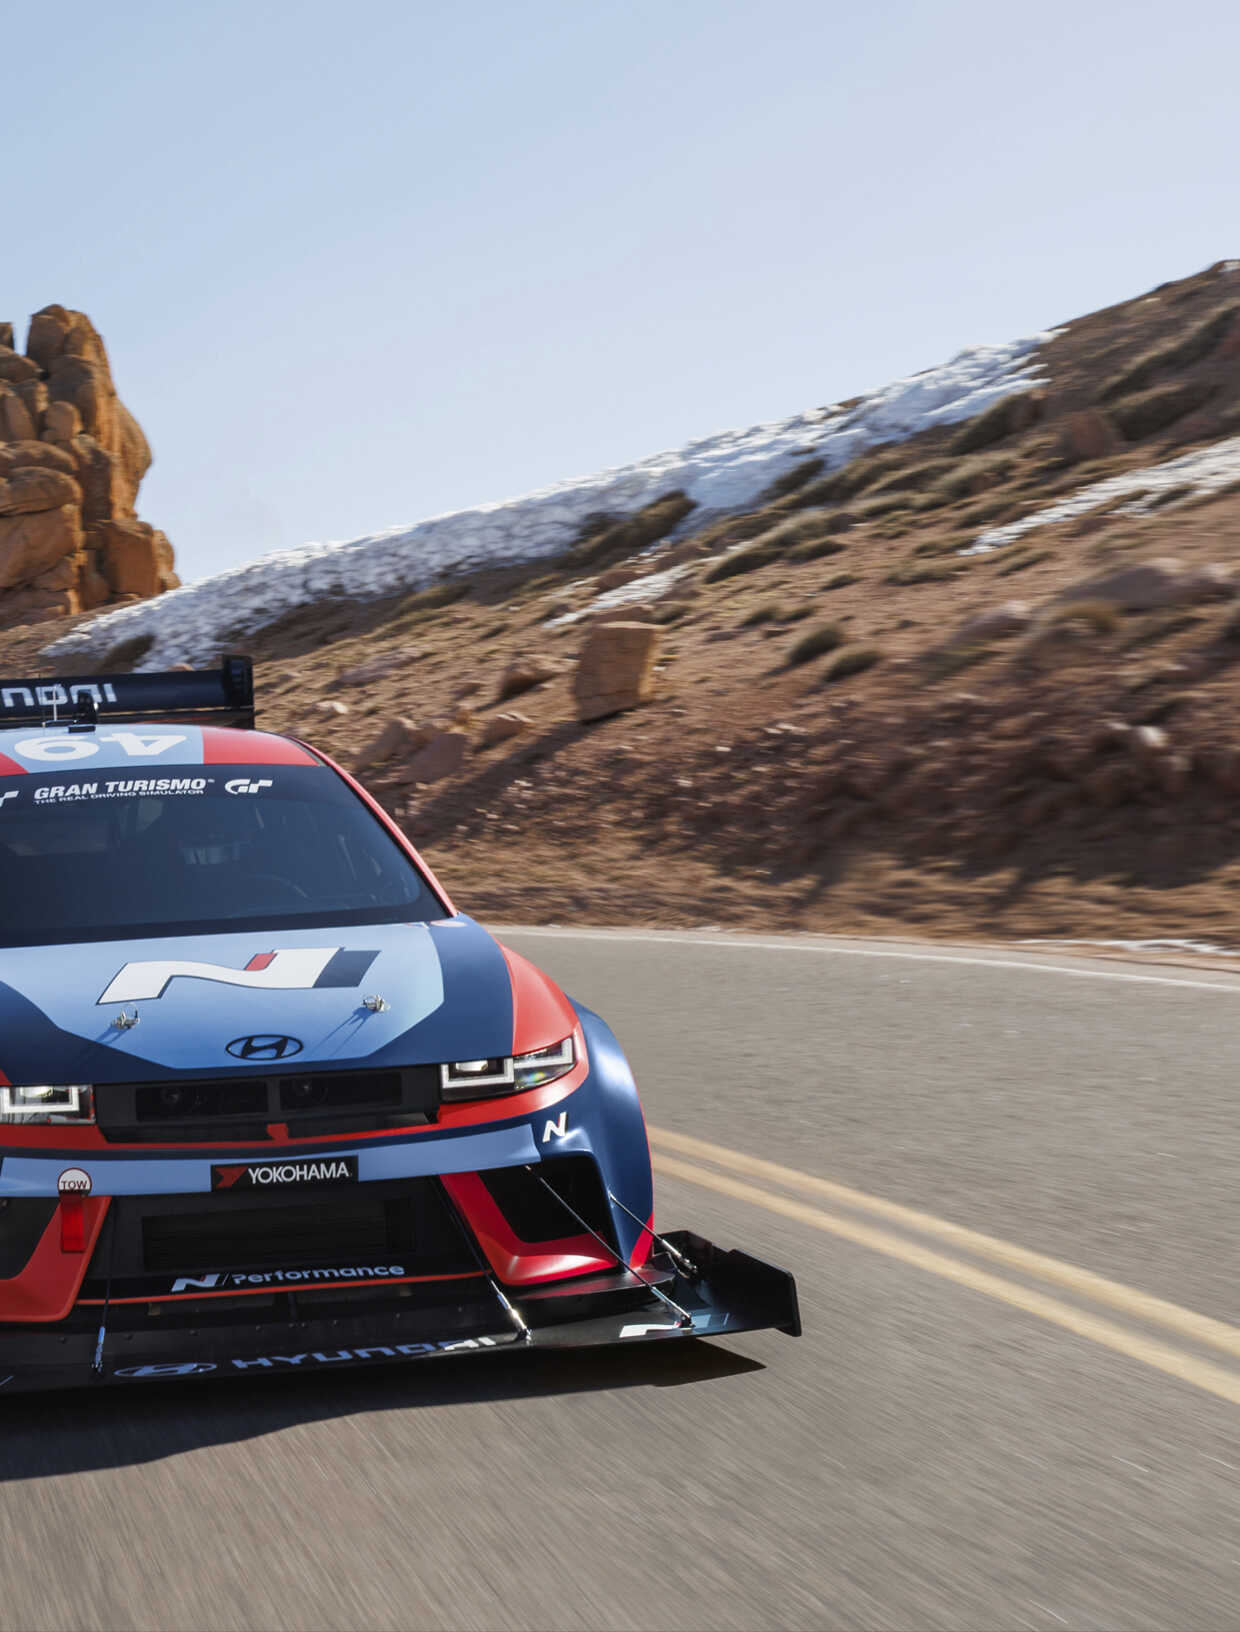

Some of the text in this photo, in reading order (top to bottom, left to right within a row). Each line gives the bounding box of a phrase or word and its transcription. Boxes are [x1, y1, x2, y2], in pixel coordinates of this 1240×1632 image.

[33, 783, 98, 800] GRAN
[59, 795, 88, 803] REAL
[90, 791, 137, 800] DRIVING
[139, 788, 205, 797] SIMULATOR
[542, 1111, 567, 1143] N
[247, 1161, 350, 1185] YOKOHAMA
[60, 1179, 88, 1191] TOW
[233, 1263, 406, 1286] Performance
[230, 1335, 498, 1370] HYUNDAI
